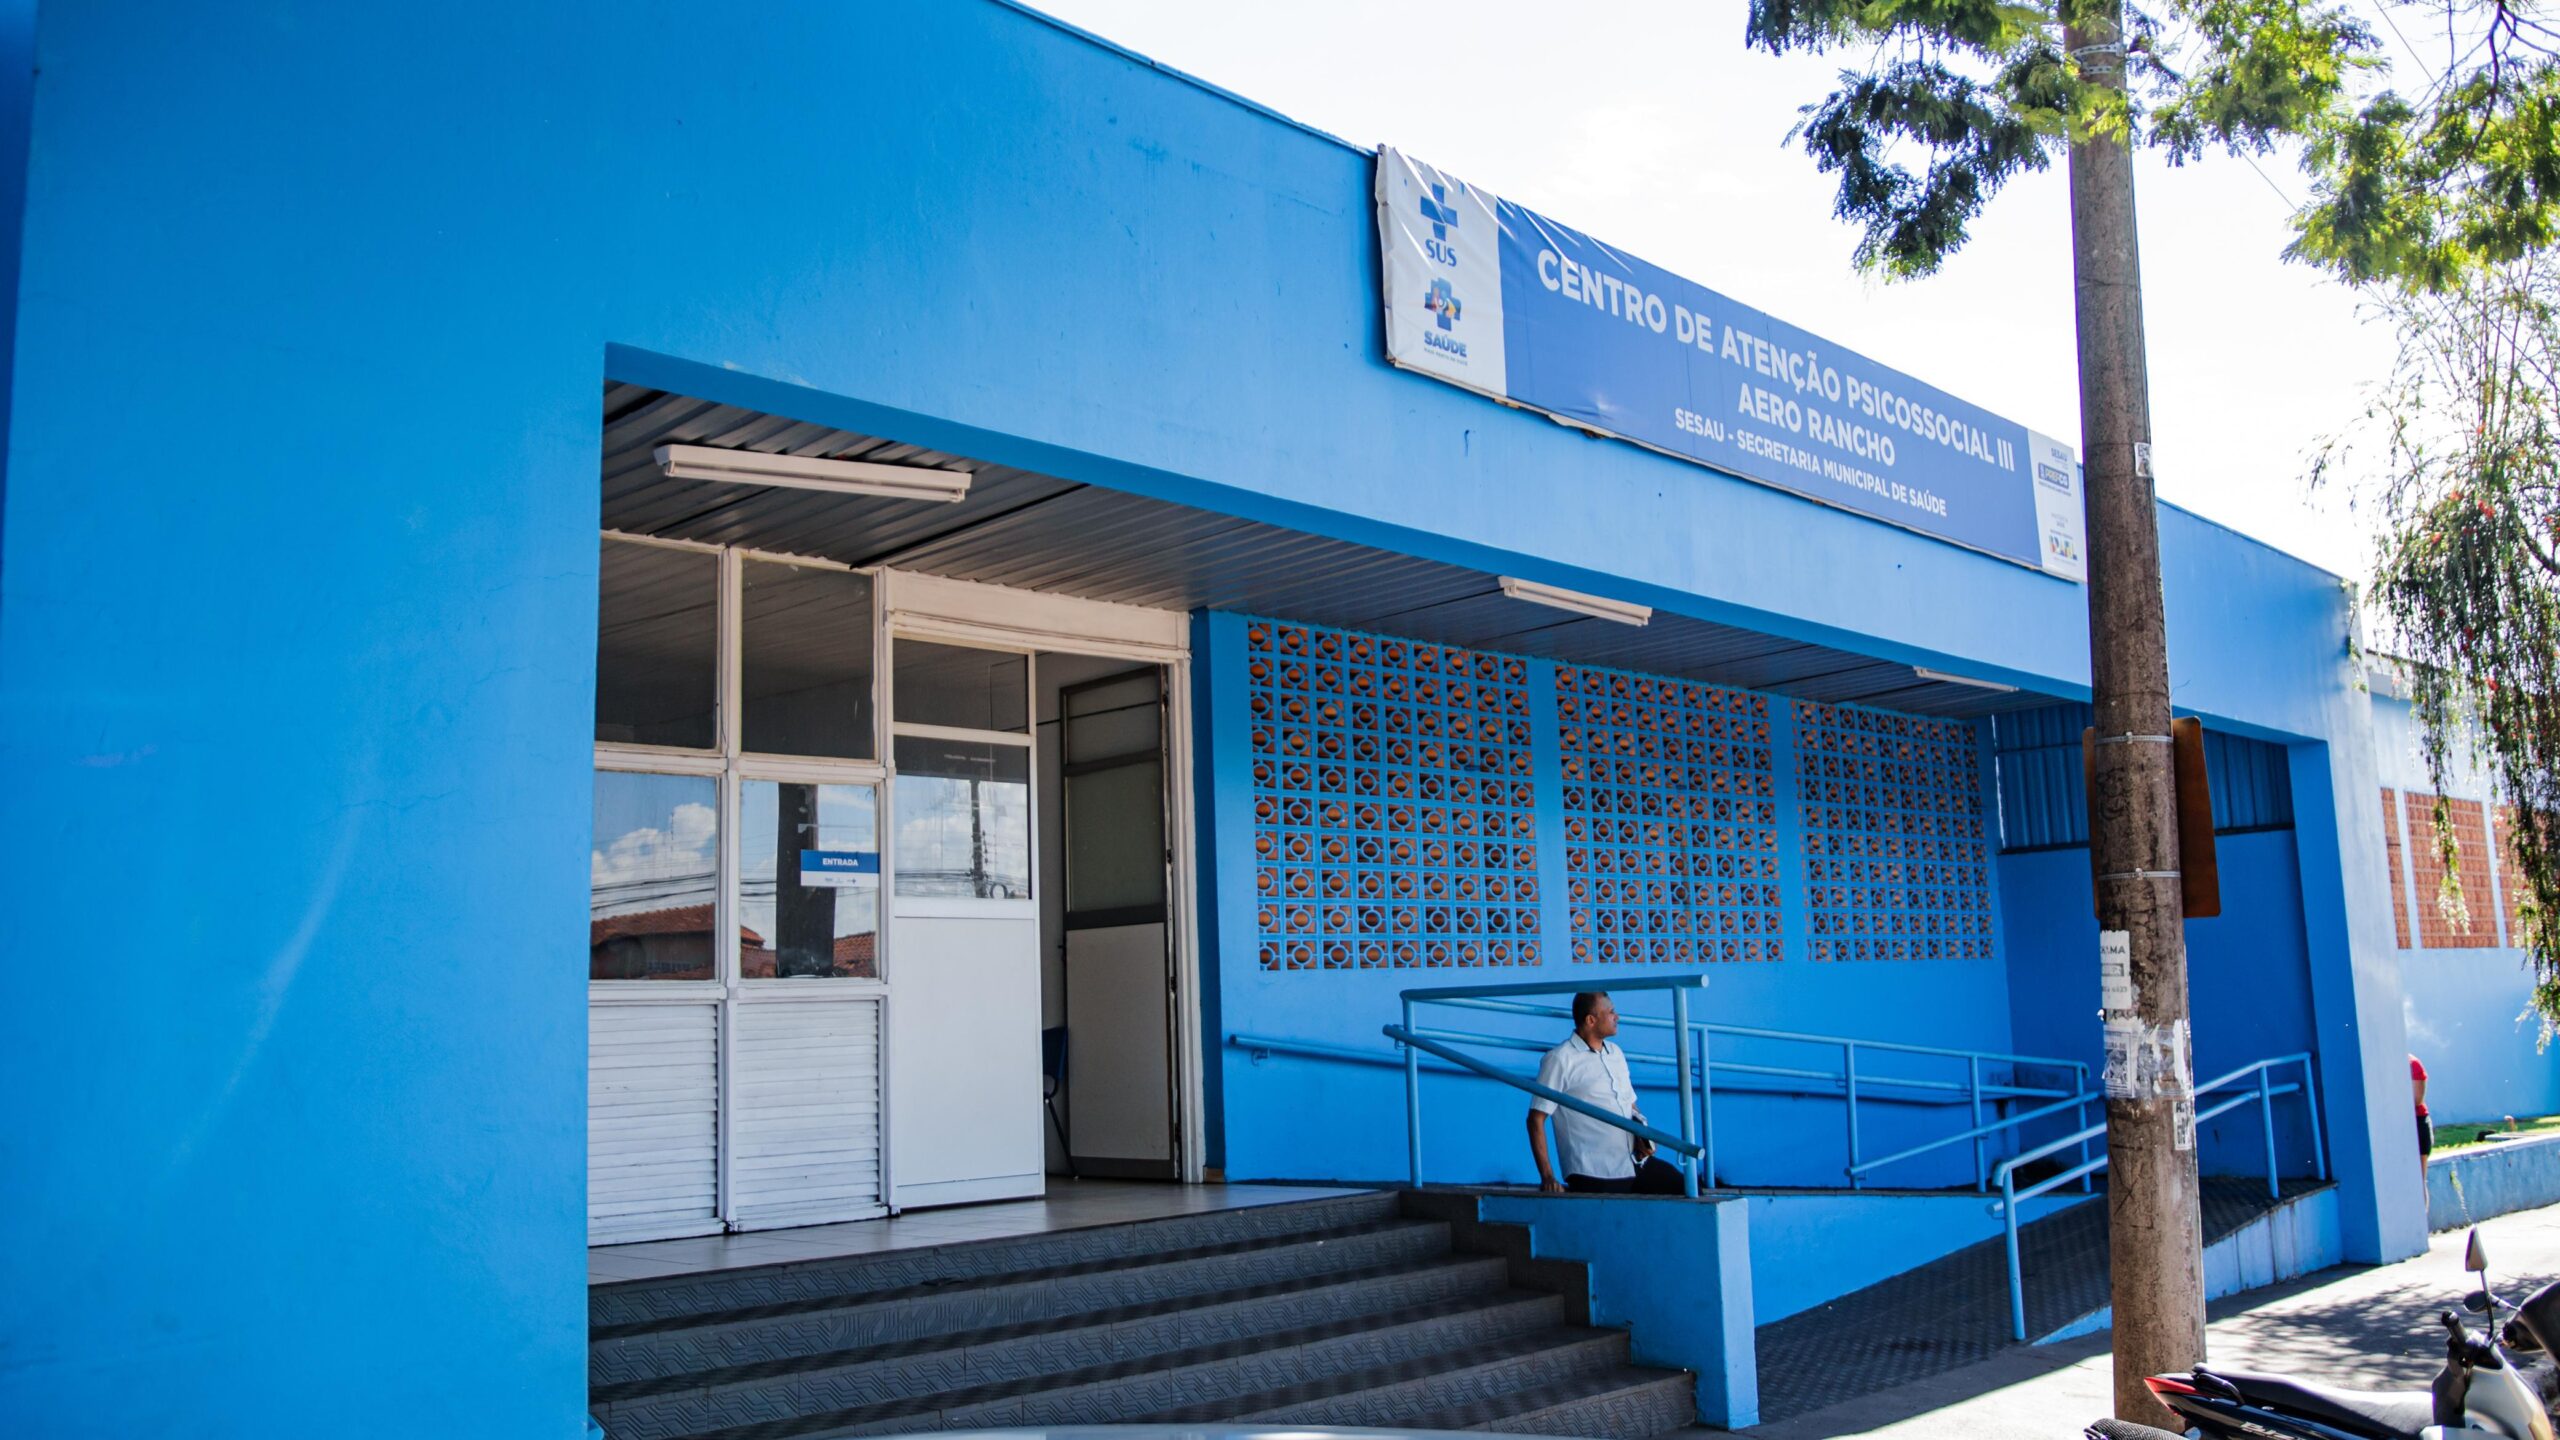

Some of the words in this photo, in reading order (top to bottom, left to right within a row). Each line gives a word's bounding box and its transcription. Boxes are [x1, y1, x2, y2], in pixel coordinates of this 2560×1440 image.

[1425, 239, 1457, 267] SUS
[1424, 330, 1468, 358] SAÚDE
[1537, 249, 1667, 334] CENTRO
[1675, 304, 1714, 353] DE
[1721, 324, 1841, 402] ATENÇÃO
[1846, 375, 1995, 464] PSICOSSOCIAL
[1997, 438, 2015, 472] III
[1738, 383, 1802, 433] AERO
[1807, 408, 1896, 467] RANCHO
[1675, 408, 1725, 443] SESAU
[1737, 430, 1821, 475] SECRETARIA
[1823, 459, 1890, 498] MUNICIPAL
[1891, 482, 1908, 504] DE
[1908, 489, 1947, 517] SAÚDE
[822, 857, 859, 867] ENTRADA
